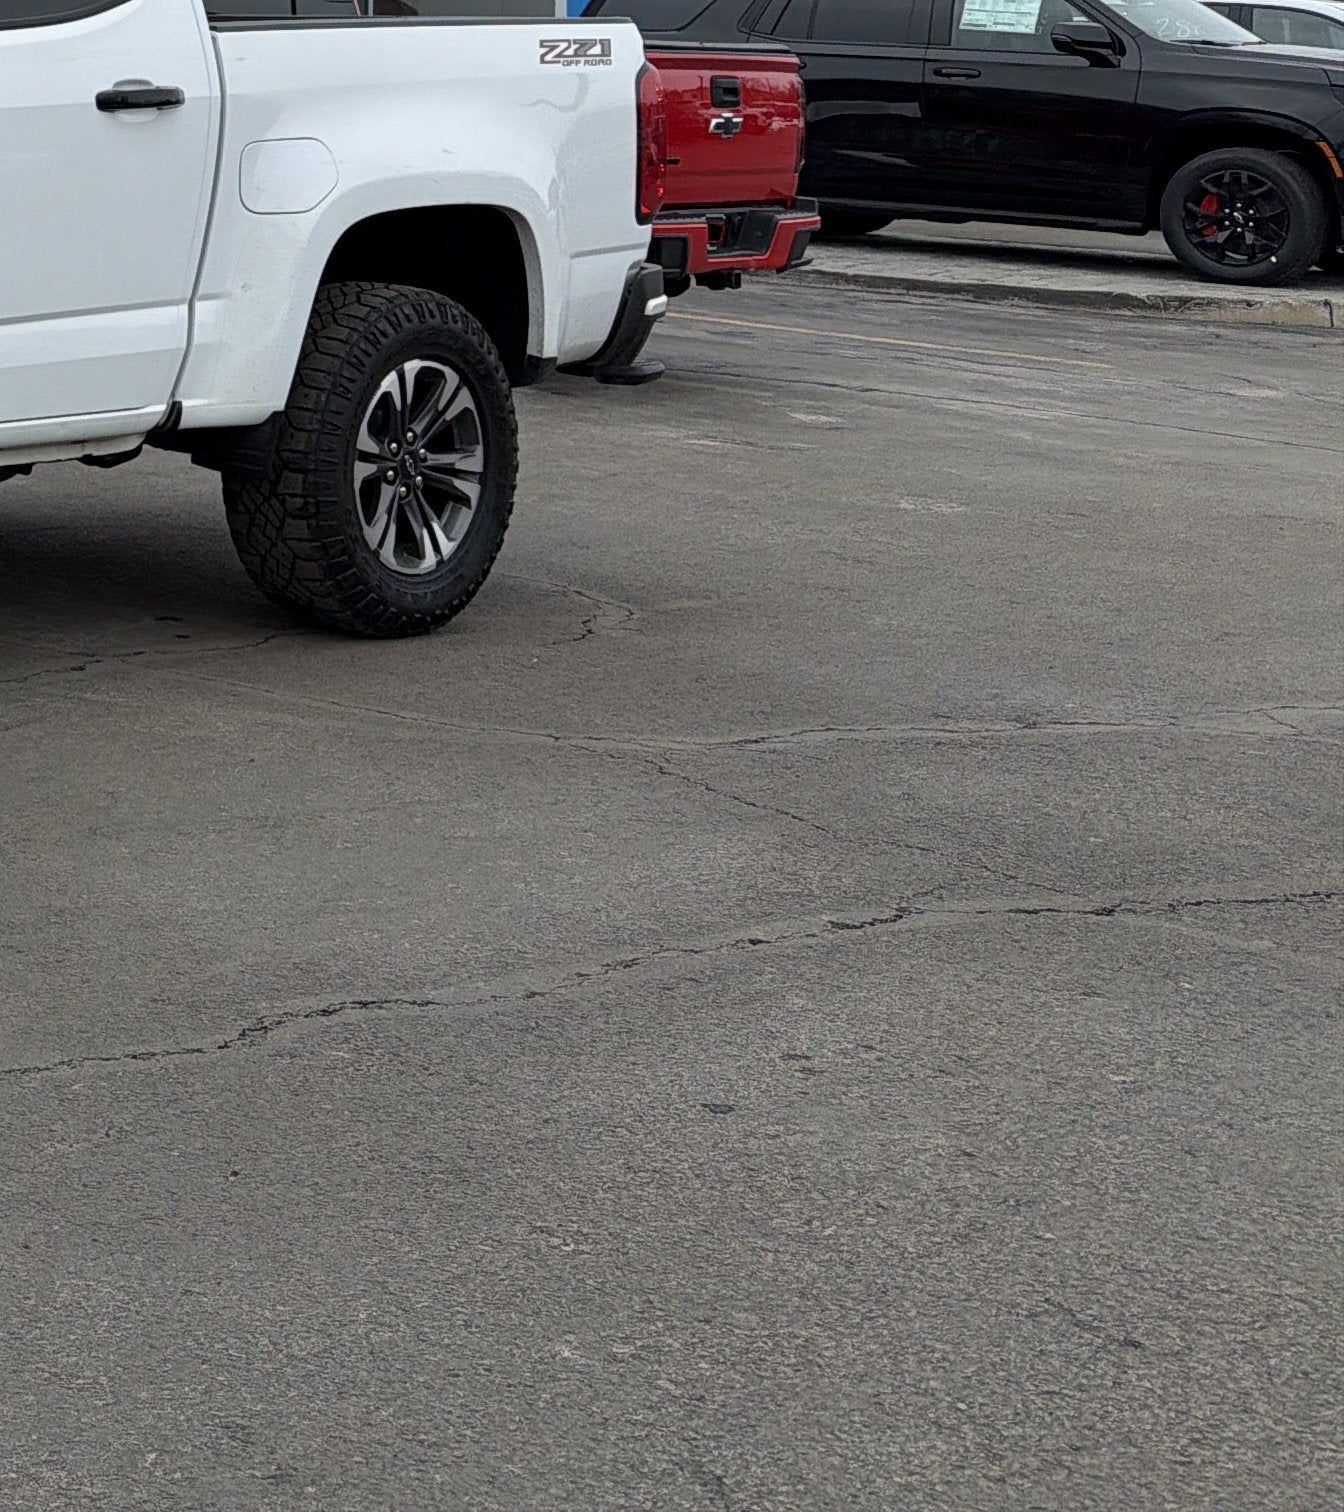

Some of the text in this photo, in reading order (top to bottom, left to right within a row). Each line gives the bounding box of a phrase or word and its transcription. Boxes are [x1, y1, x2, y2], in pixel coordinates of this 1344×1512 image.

[539, 39, 611, 64] Z71
[562, 58, 613, 67] OFF ROAD
